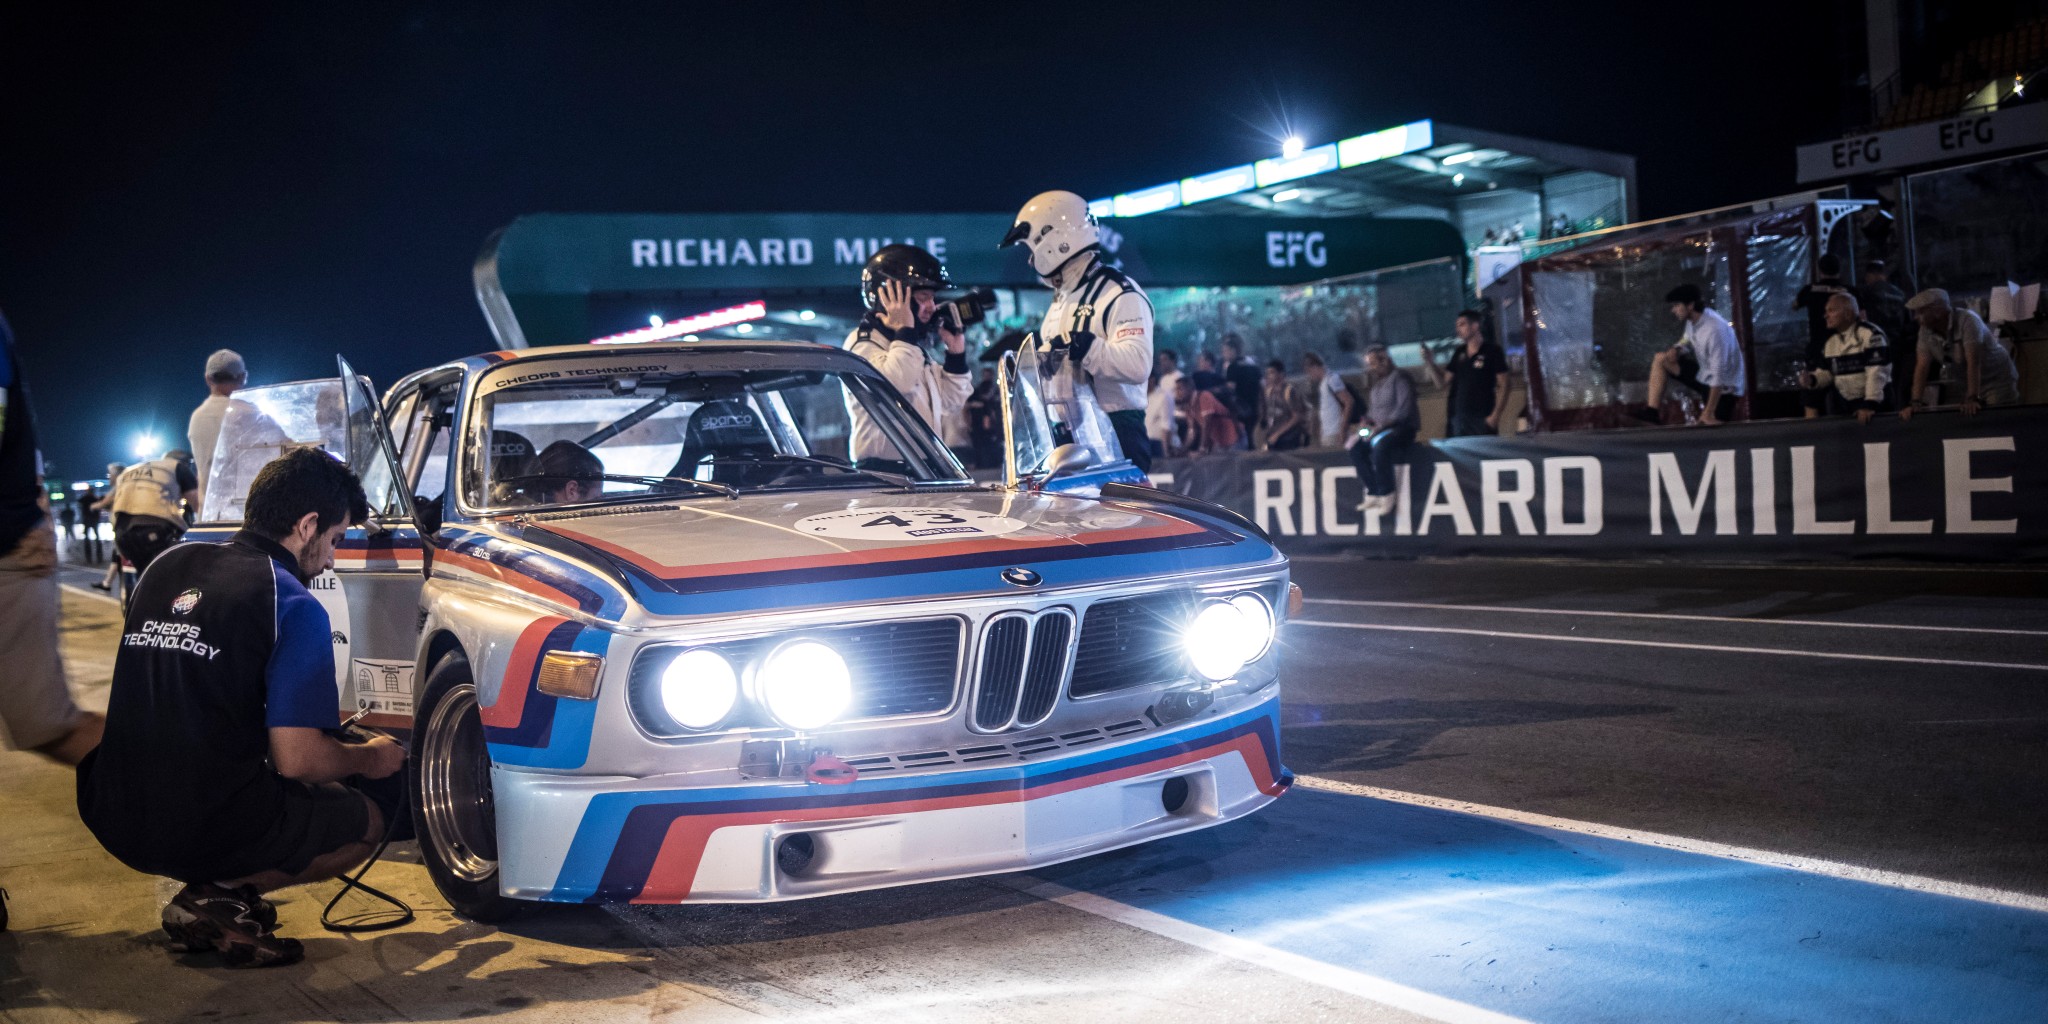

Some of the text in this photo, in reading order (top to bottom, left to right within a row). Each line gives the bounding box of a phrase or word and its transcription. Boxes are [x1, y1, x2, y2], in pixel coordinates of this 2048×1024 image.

[1939, 116, 1994, 150] EFG
[1831, 136, 1882, 169] EFG
[631, 237, 947, 267] RICHARD MIE
[1266, 231, 1327, 267] EFG
[495, 364, 669, 389] CHEOPS TECHNOLOGY
[700, 413, 752, 427] sparco
[1647, 436, 2018, 535] MILLE
[860, 513, 968, 528] 43
[308, 578, 336, 590] ILLE
[142, 620, 202, 639] CHEOPS
[124, 633, 221, 660] TECHNOLOGY
